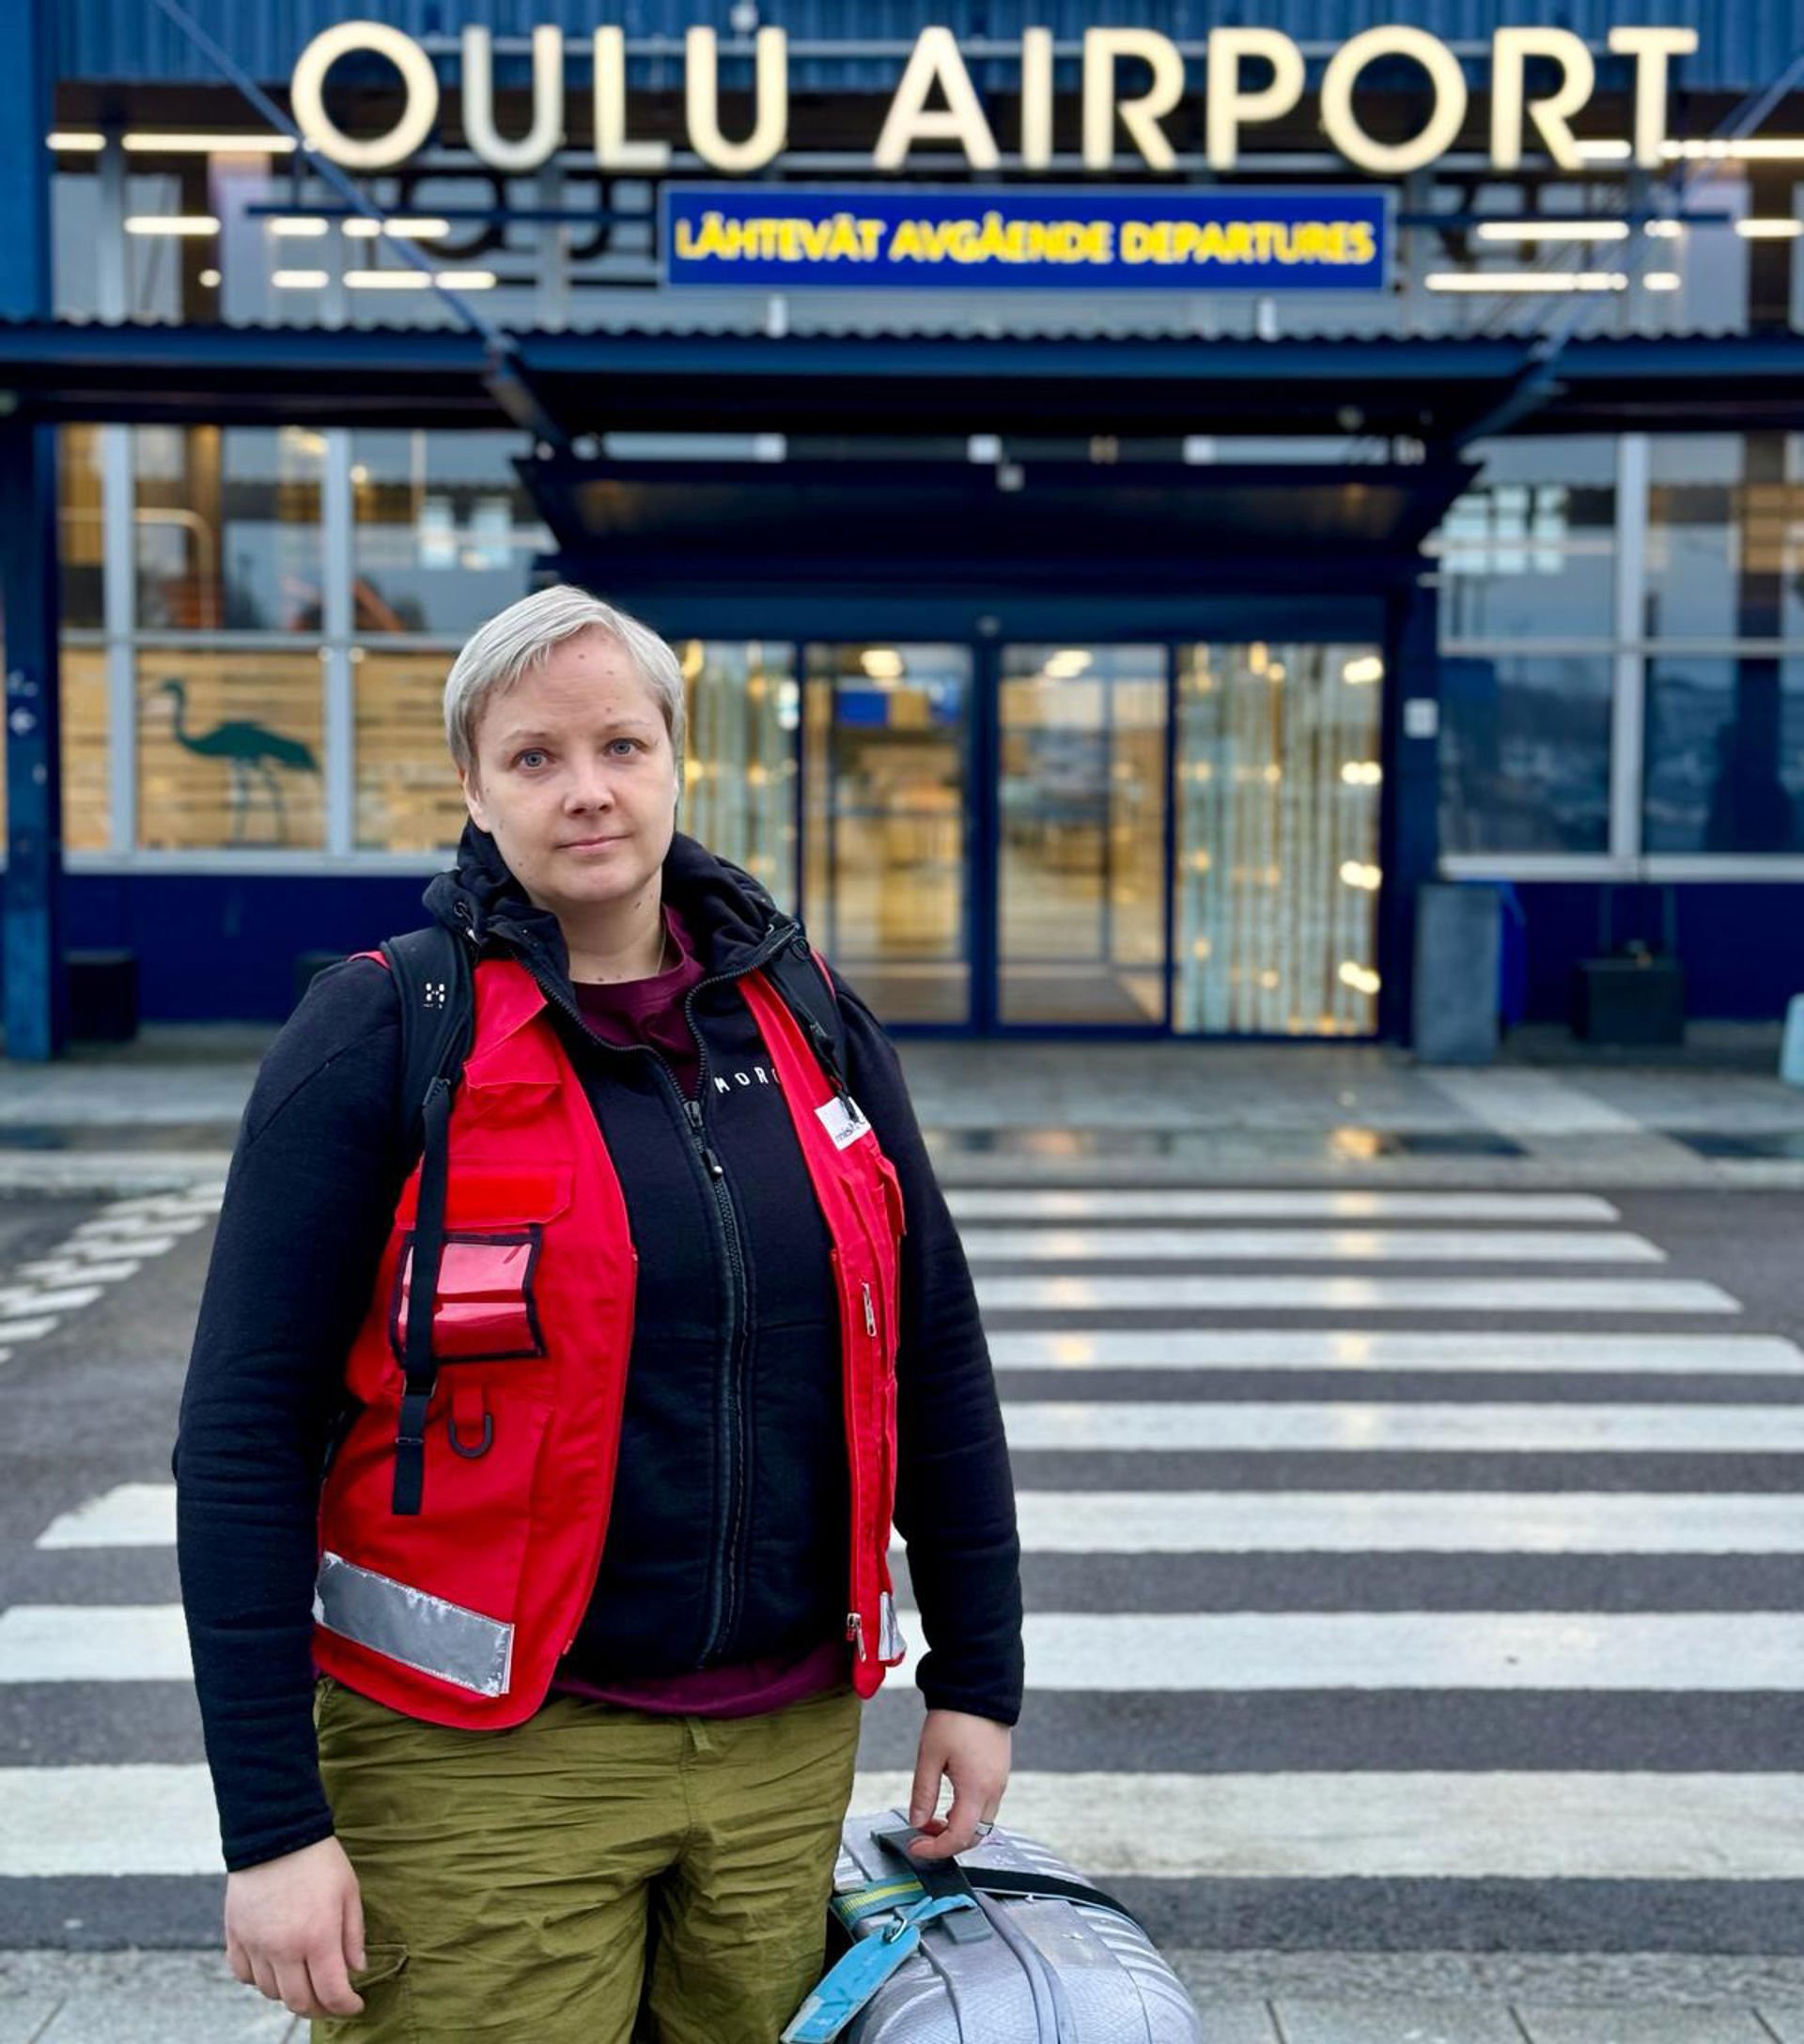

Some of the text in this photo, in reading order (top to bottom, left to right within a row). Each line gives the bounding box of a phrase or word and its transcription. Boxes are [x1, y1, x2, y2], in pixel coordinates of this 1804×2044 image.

[290, 20, 1699, 175] OULU AIRPORT
[675, 210, 1376, 265] LÄHTEVÄT AVGÅENDE DEPARTURES
